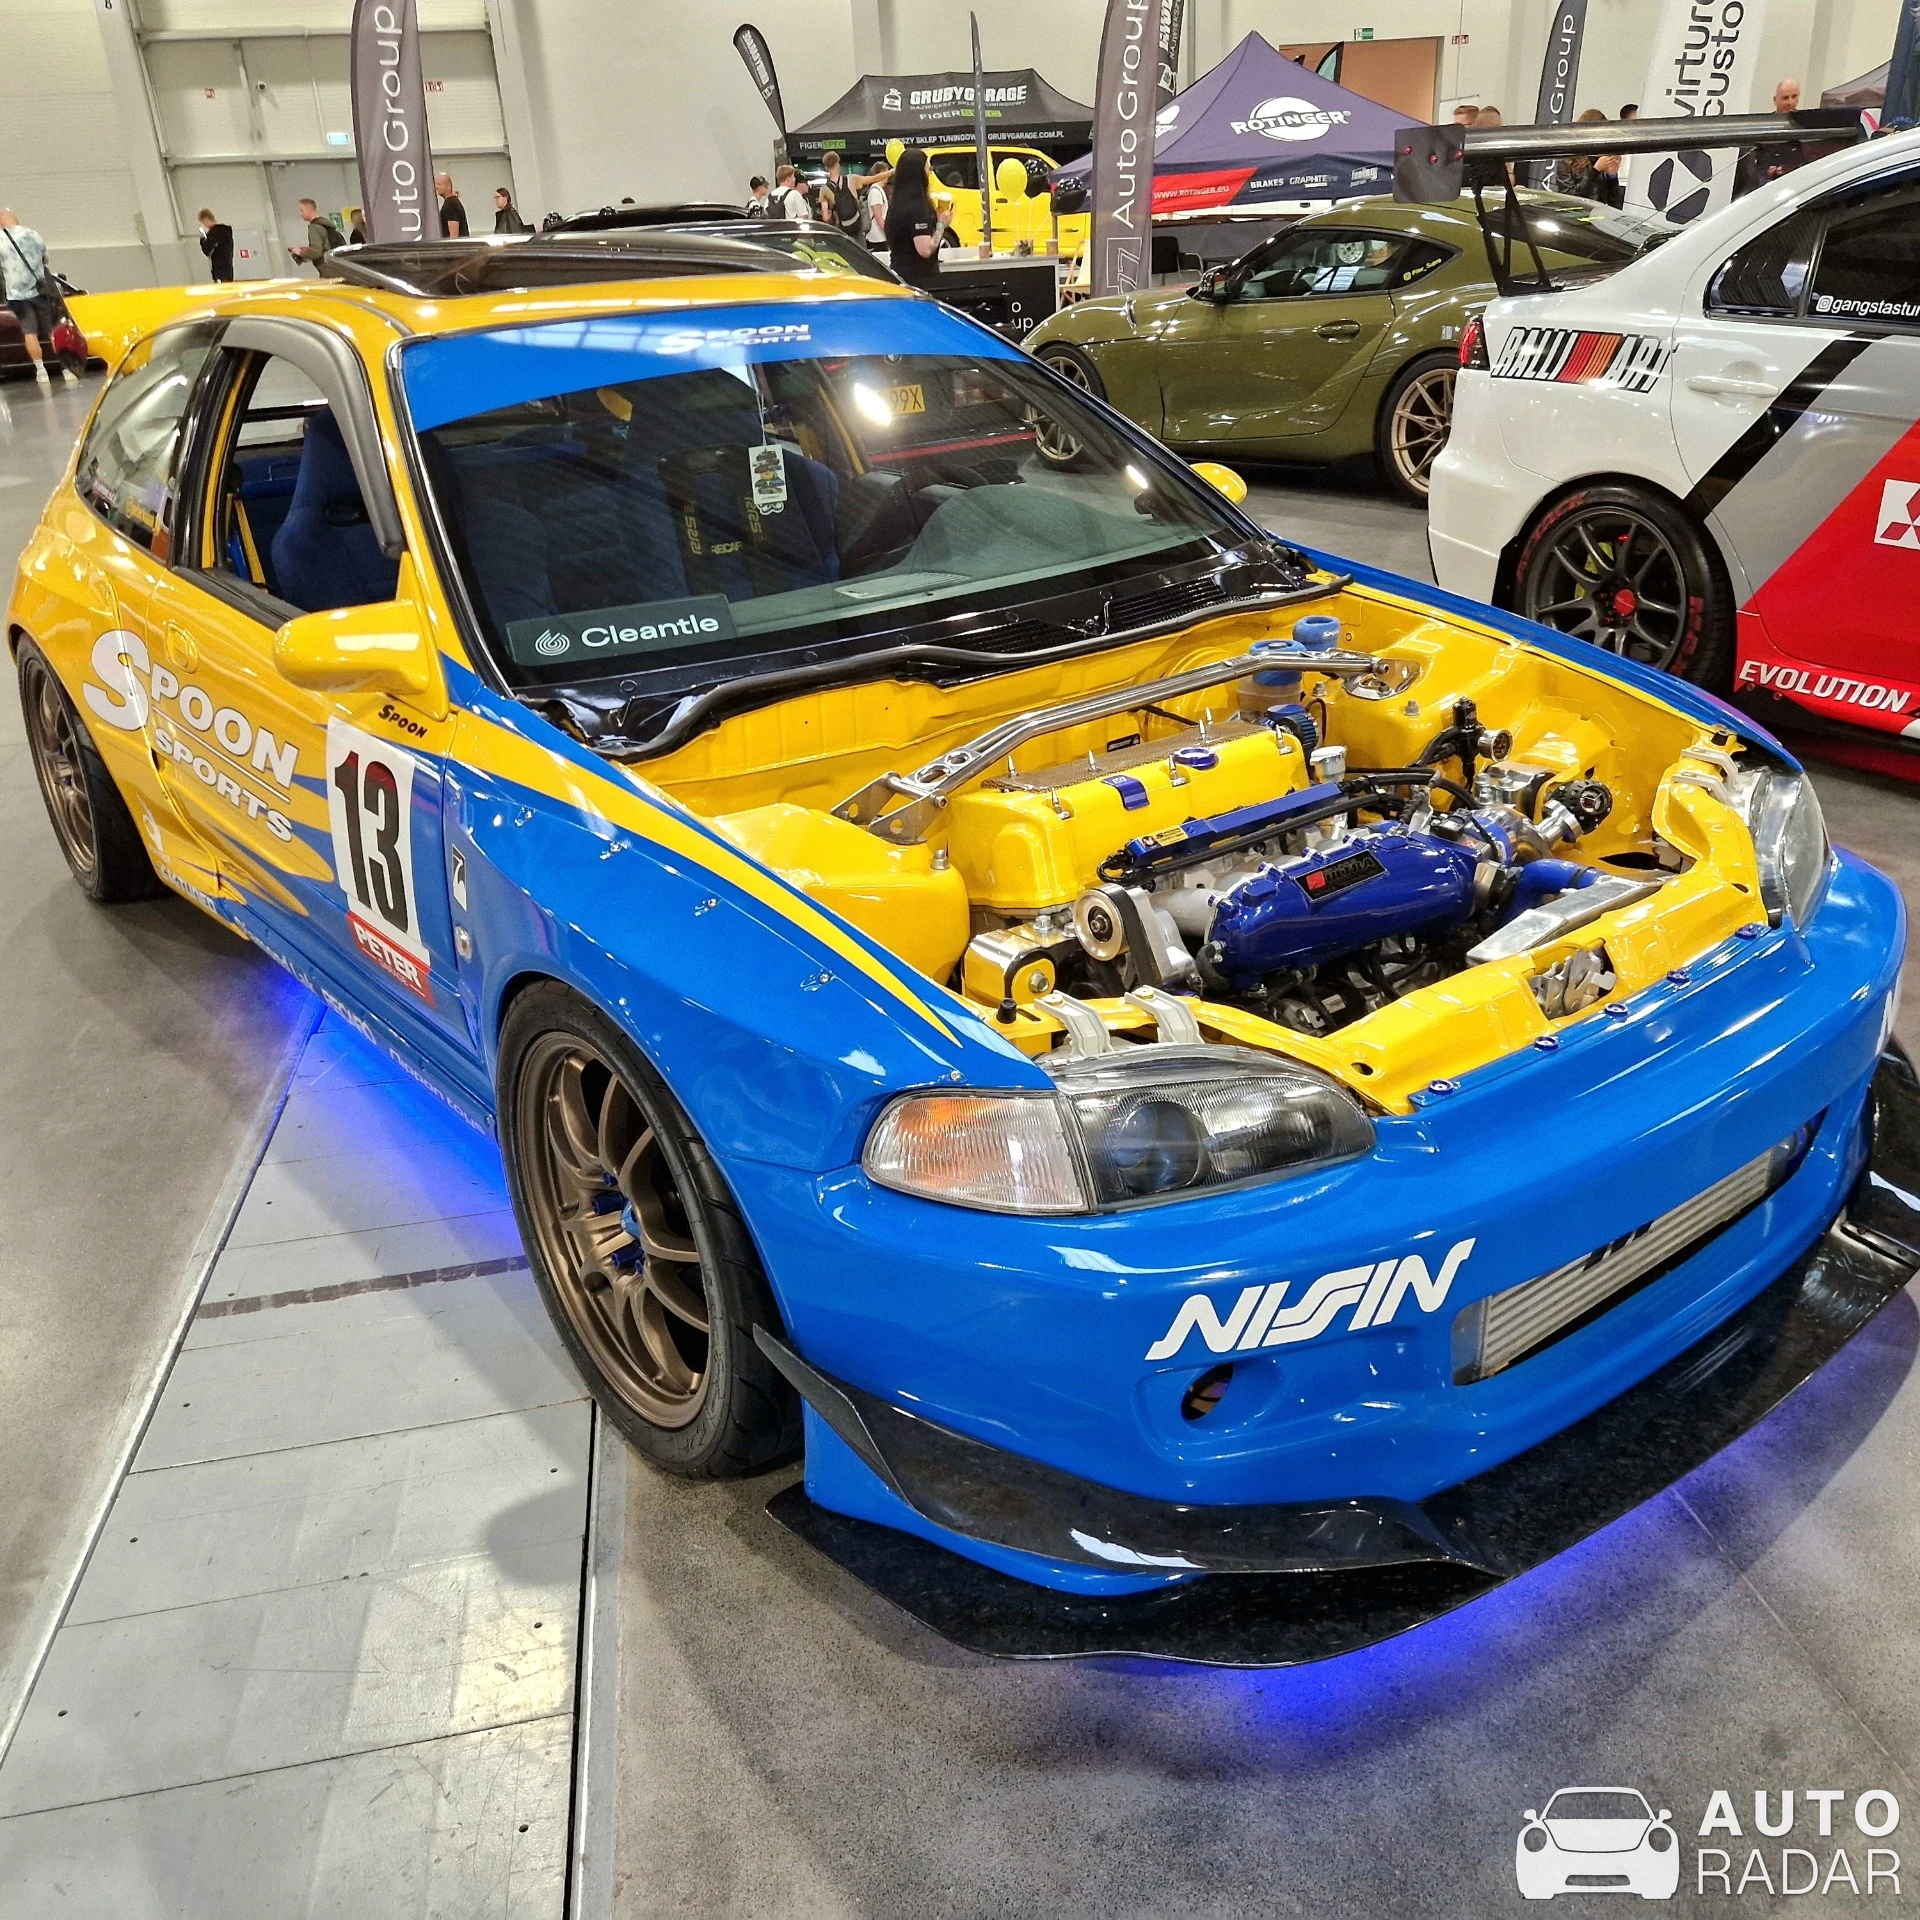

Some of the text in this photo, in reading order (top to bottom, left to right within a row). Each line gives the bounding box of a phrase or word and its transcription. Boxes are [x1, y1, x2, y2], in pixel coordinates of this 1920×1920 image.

[910, 85, 1028, 105] GRUBYGRAGE
[1551, 14, 1576, 114] Group
[374, 5, 422, 241] uto Group
[916, 135, 937, 144] SKLEP
[938, 133, 977, 142] TUNINGOW
[987, 130, 1065, 141] GRUBYGARAGE.COM.PL
[1113, 129, 1138, 229] Auto
[1250, 177, 1284, 189] BRAKES
[656, 323, 810, 355] SPOON
[581, 614, 720, 648] Cleantle
[83, 629, 300, 792] SPOON
[1739, 659, 1912, 714] EVOLUTION
[378, 705, 429, 738] SPOON
[155, 729, 293, 843] SPORTS
[334, 750, 408, 934] 13
[353, 921, 423, 989] PETER
[1144, 1237, 1476, 1361] NISSIN
